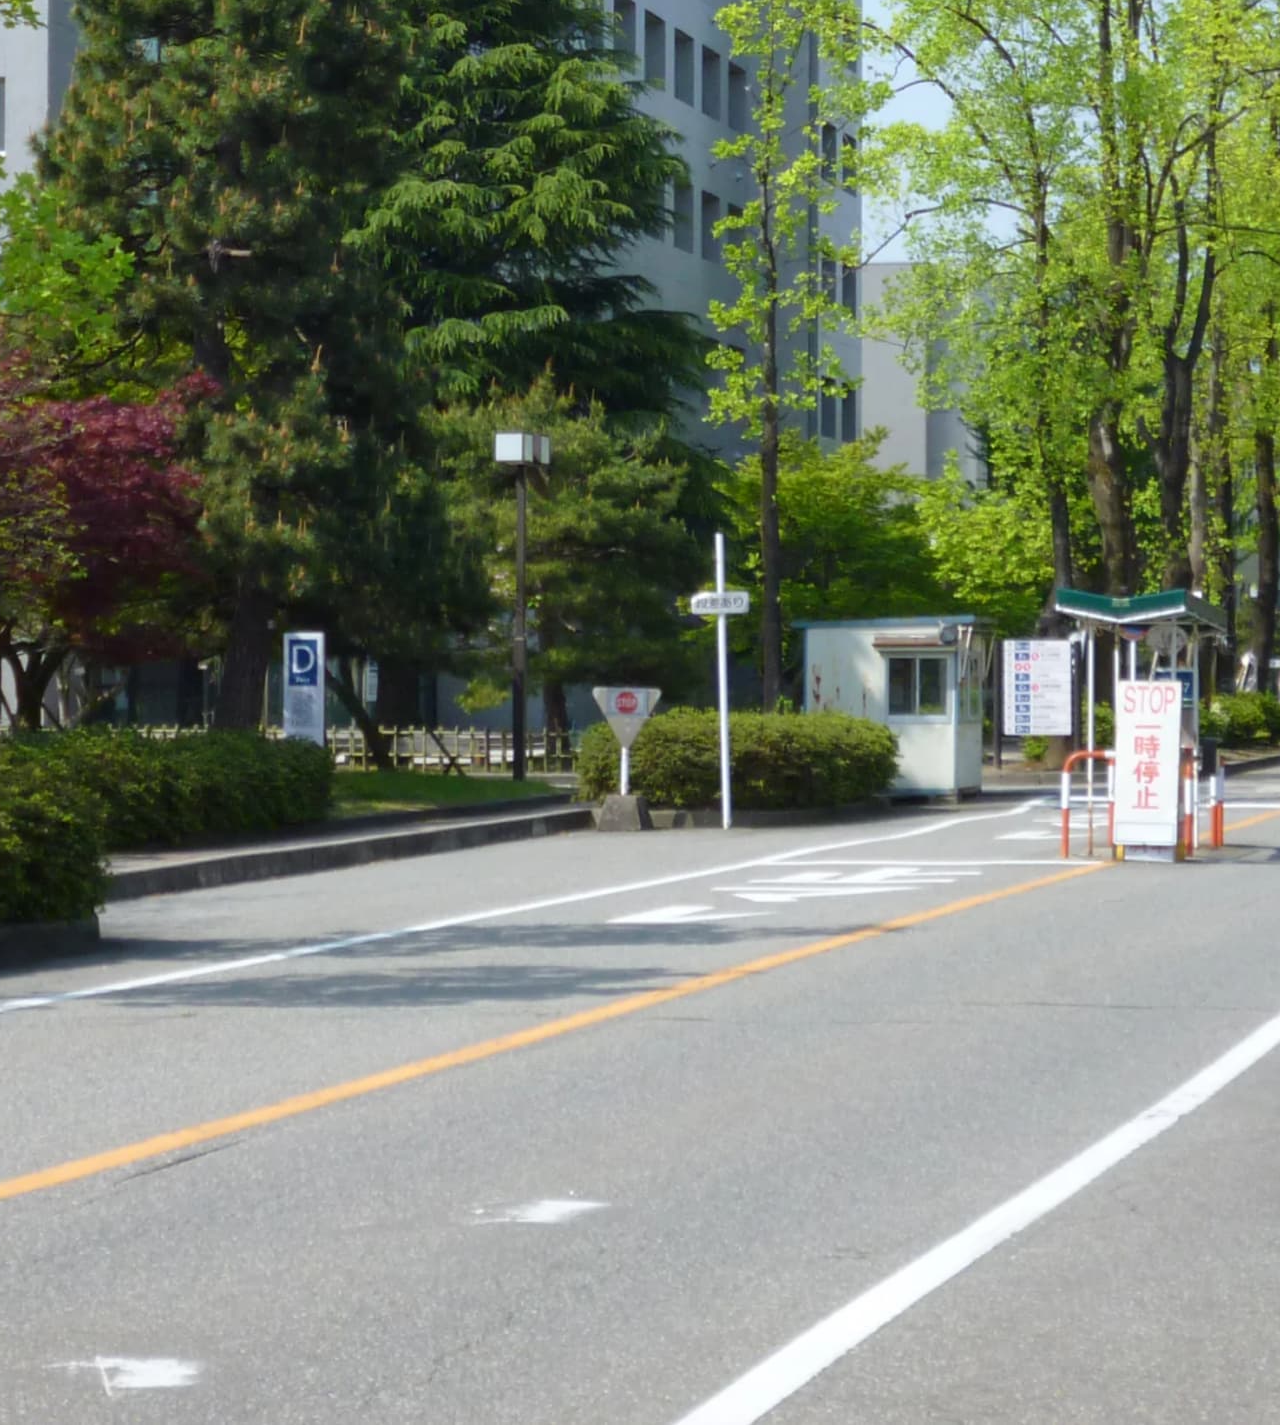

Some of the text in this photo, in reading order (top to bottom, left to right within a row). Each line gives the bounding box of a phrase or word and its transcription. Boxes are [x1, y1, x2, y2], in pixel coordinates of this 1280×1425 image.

[293, 645, 315, 673] D
[1123, 685, 1176, 713] STOP
[1132, 724, 1162, 809] 一時停止
